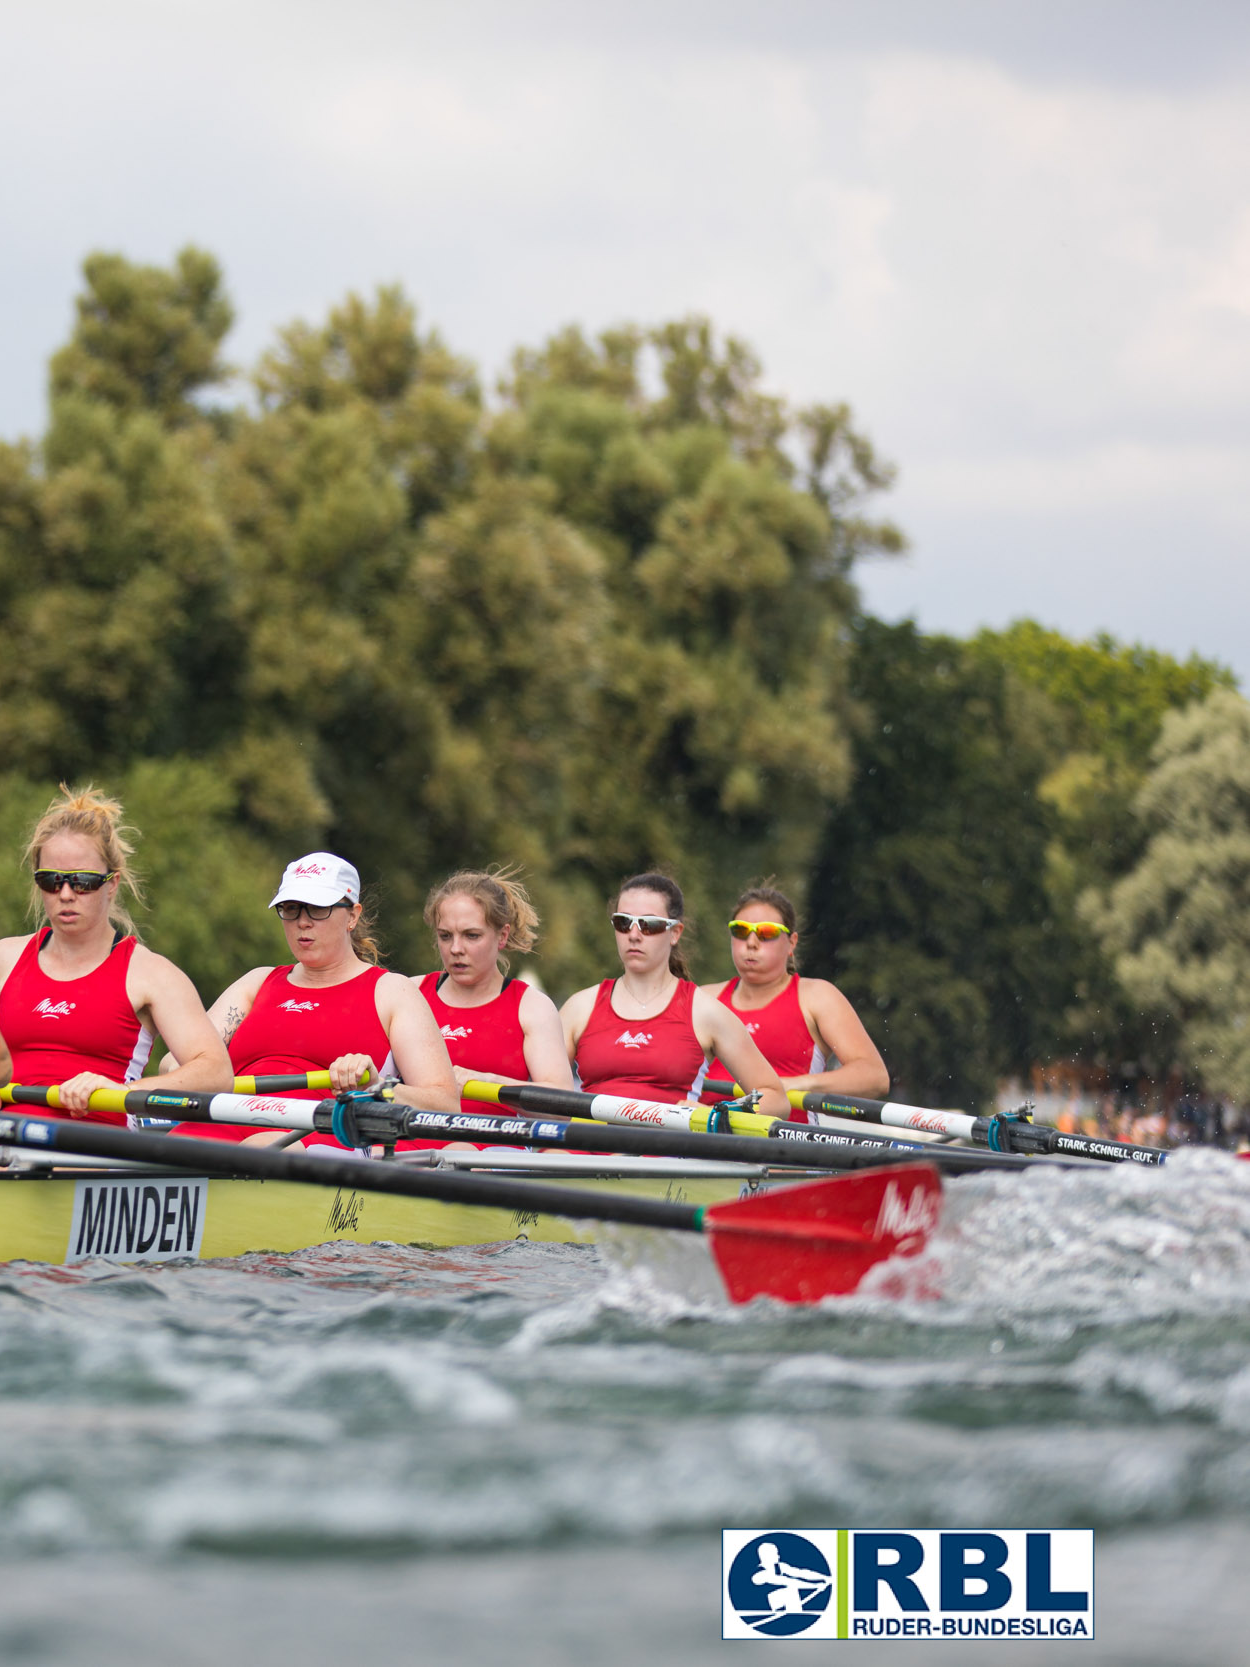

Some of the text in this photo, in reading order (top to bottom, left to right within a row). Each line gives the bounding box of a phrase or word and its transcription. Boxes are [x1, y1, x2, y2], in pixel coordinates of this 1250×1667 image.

[414, 1112, 450, 1127] STARK.
[450, 1115, 501, 1132] SCHNELL.
[500, 1120, 527, 1135] GUT.
[614, 1100, 666, 1127] Melitta
[903, 1108, 950, 1135] Melitta
[778, 1128, 812, 1142] STARK.
[861, 1139, 884, 1149] GUT
[1057, 1137, 1088, 1151] STARK.
[1089, 1142, 1131, 1159] SCHNELL.
[1132, 1150, 1154, 1164] GUT.
[75, 1186, 200, 1256] MINDEN
